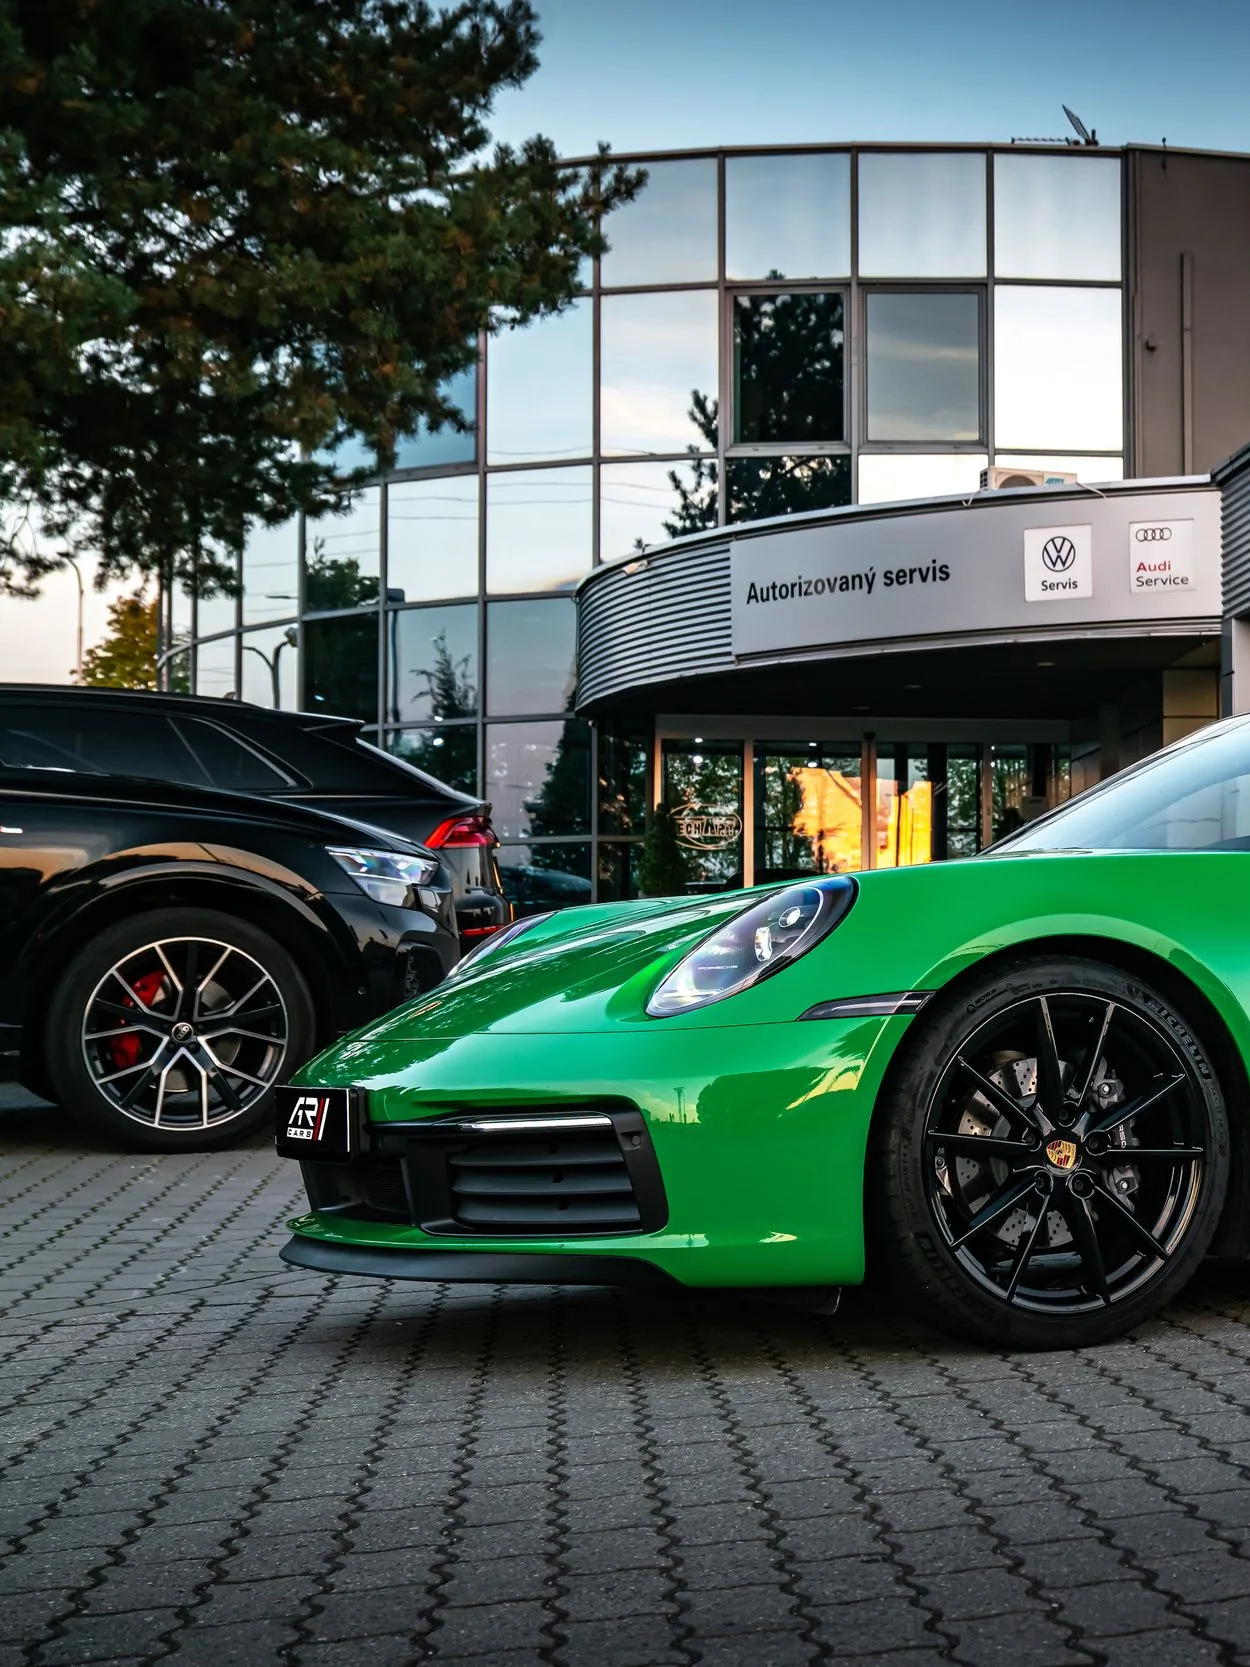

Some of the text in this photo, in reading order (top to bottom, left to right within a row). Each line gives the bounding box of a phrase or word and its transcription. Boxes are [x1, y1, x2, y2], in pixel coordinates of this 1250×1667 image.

[1136, 560, 1172, 573] Audi
[746, 559, 950, 605] Autorizovaný servis
[1041, 578, 1078, 592] Servis
[1136, 574, 1189, 588] Service
[288, 1129, 311, 1138] CARS
